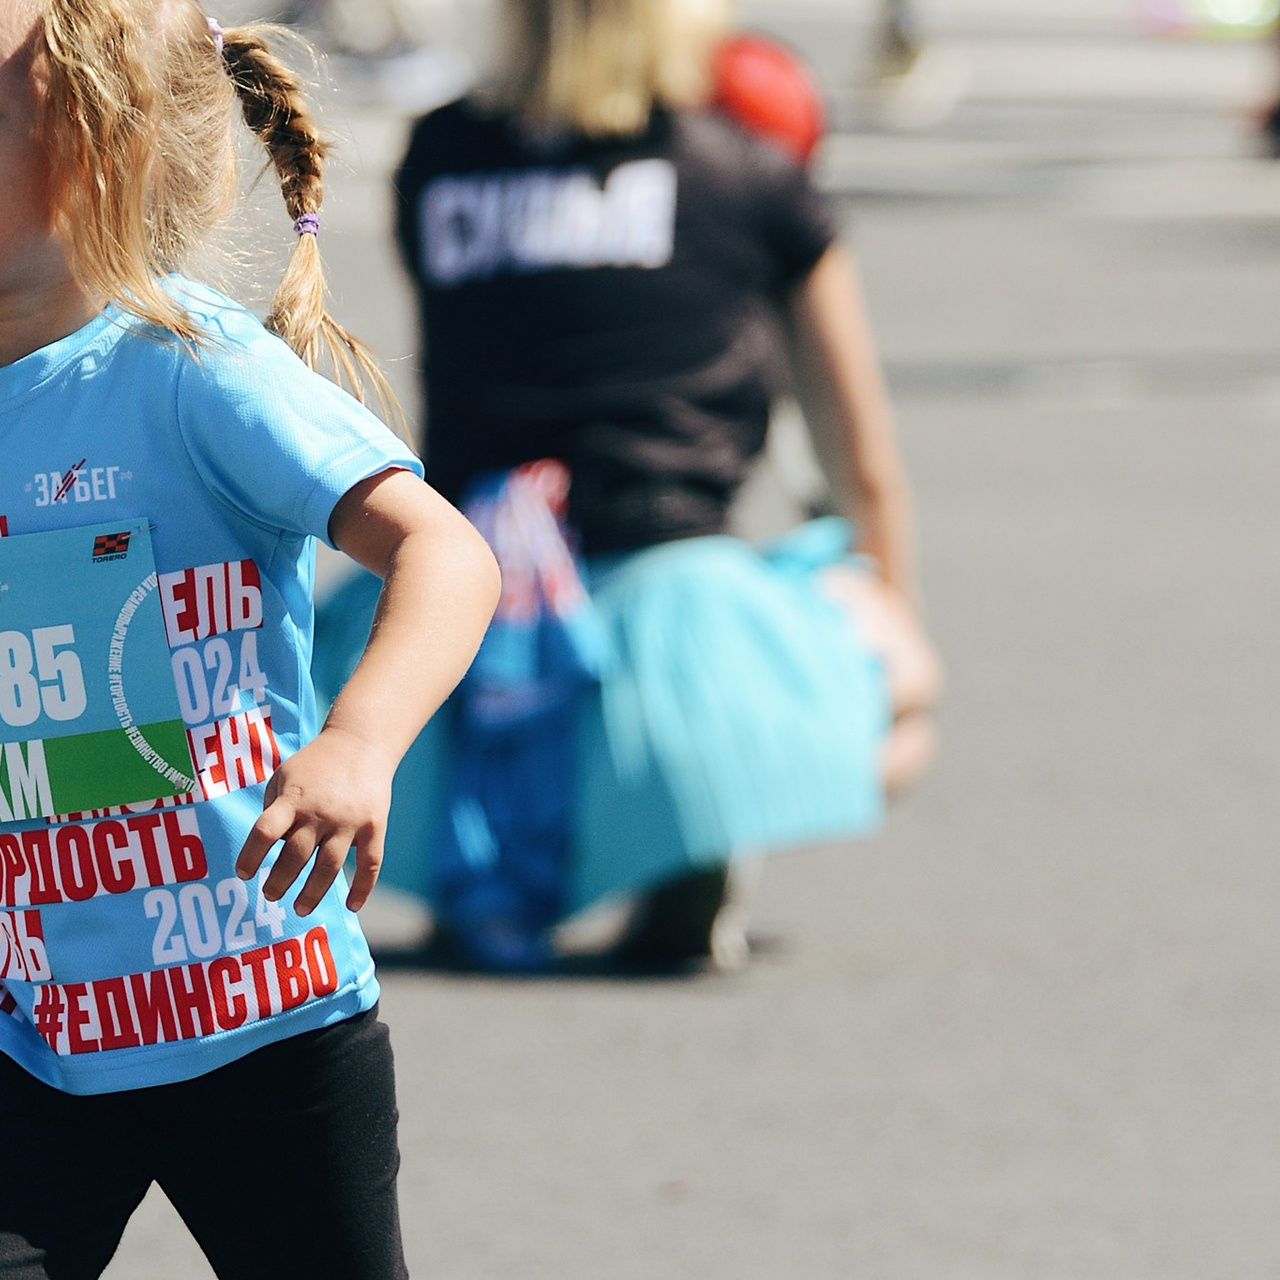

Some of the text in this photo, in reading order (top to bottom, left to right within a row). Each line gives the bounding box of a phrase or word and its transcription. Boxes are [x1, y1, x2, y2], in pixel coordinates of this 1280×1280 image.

[91, 553, 127, 563] TORERO
[158, 560, 264, 648] ЕЛЬ
[171, 631, 269, 725] 024
[143, 866, 286, 966] 2024
[33, 926, 339, 1054] #ЕДИНСТВО
